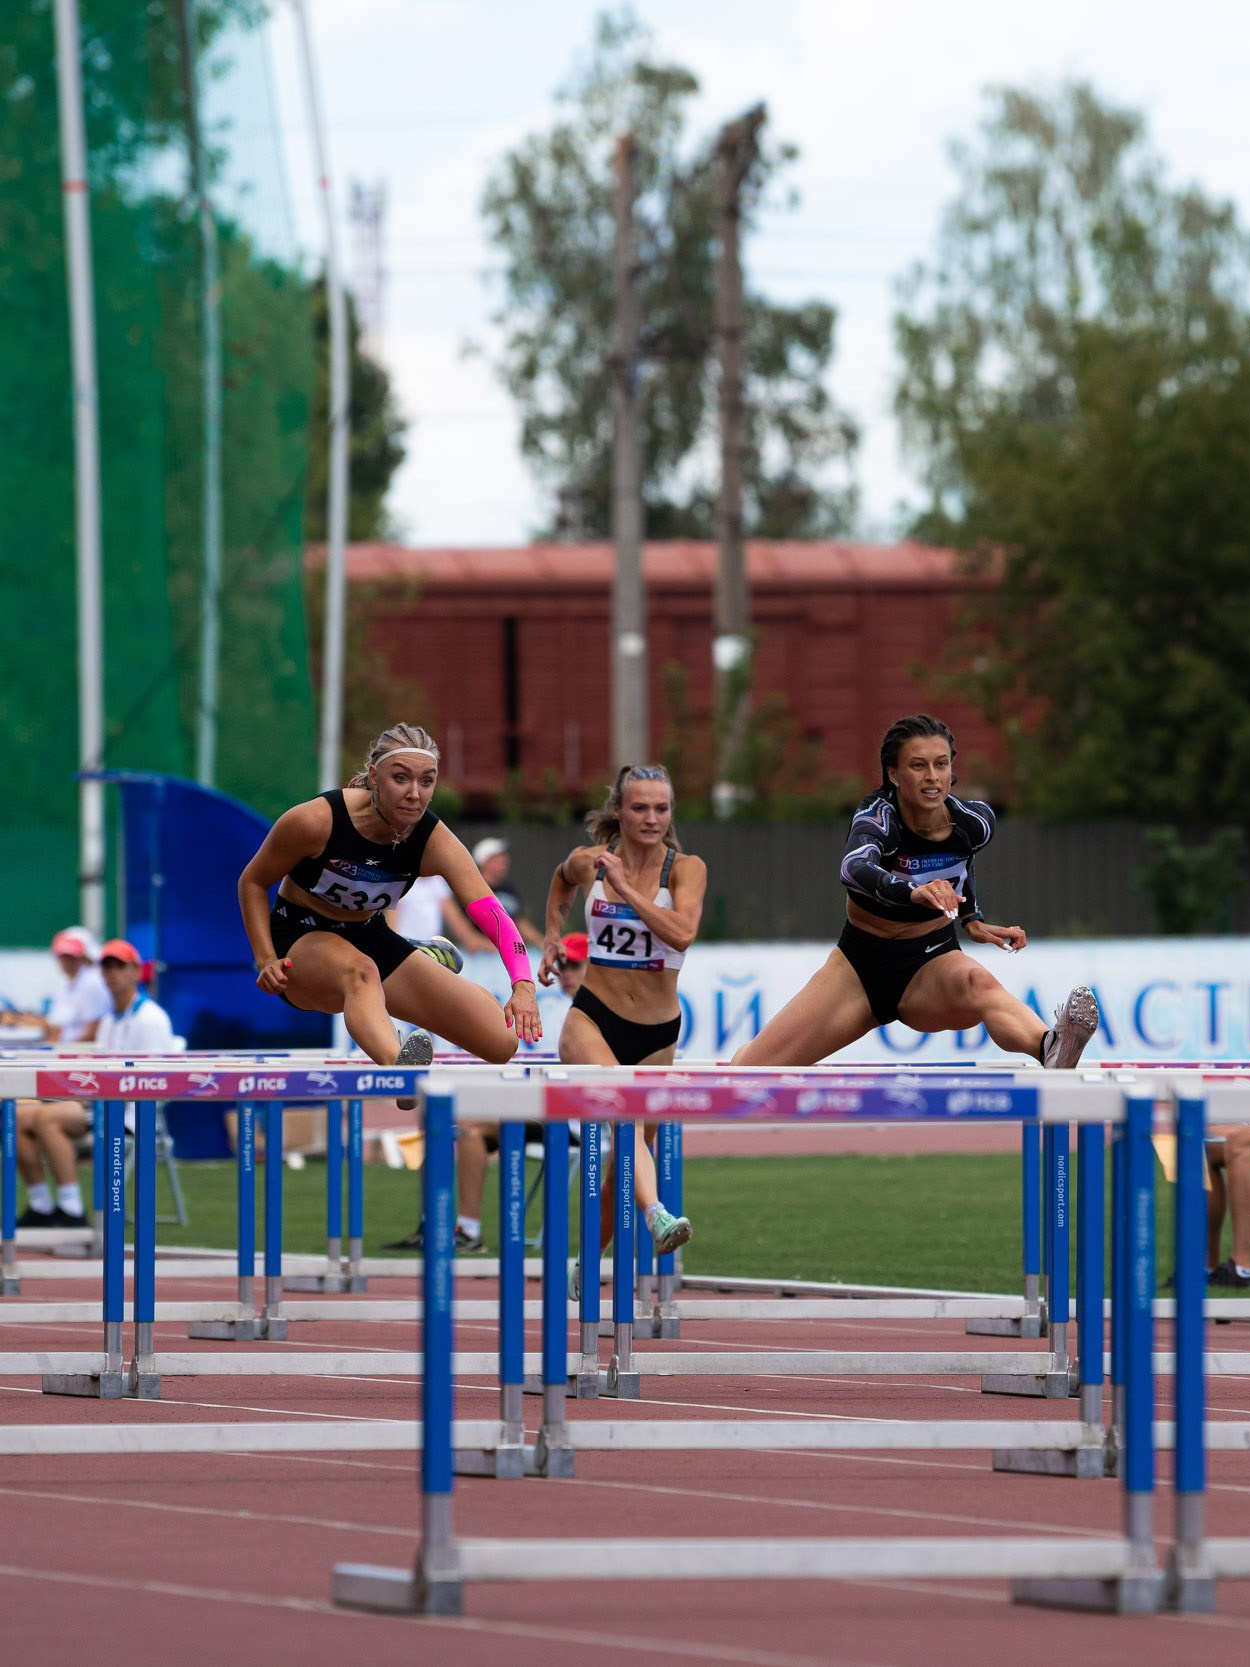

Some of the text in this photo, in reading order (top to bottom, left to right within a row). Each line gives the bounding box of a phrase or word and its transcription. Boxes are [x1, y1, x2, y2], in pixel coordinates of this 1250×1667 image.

[594, 901, 617, 915] U23
[596, 924, 652, 958] 421
[138, 1077, 168, 1091] ПСБ
[257, 1077, 287, 1091] ПСБ
[375, 1076, 405, 1090] ПСБ
[112, 1178, 121, 1213] Sport
[587, 1163, 597, 1198] Sport
[622, 1155, 633, 1229] nordicsport.com
[1055, 1155, 1067, 1228] nordicsport.com
